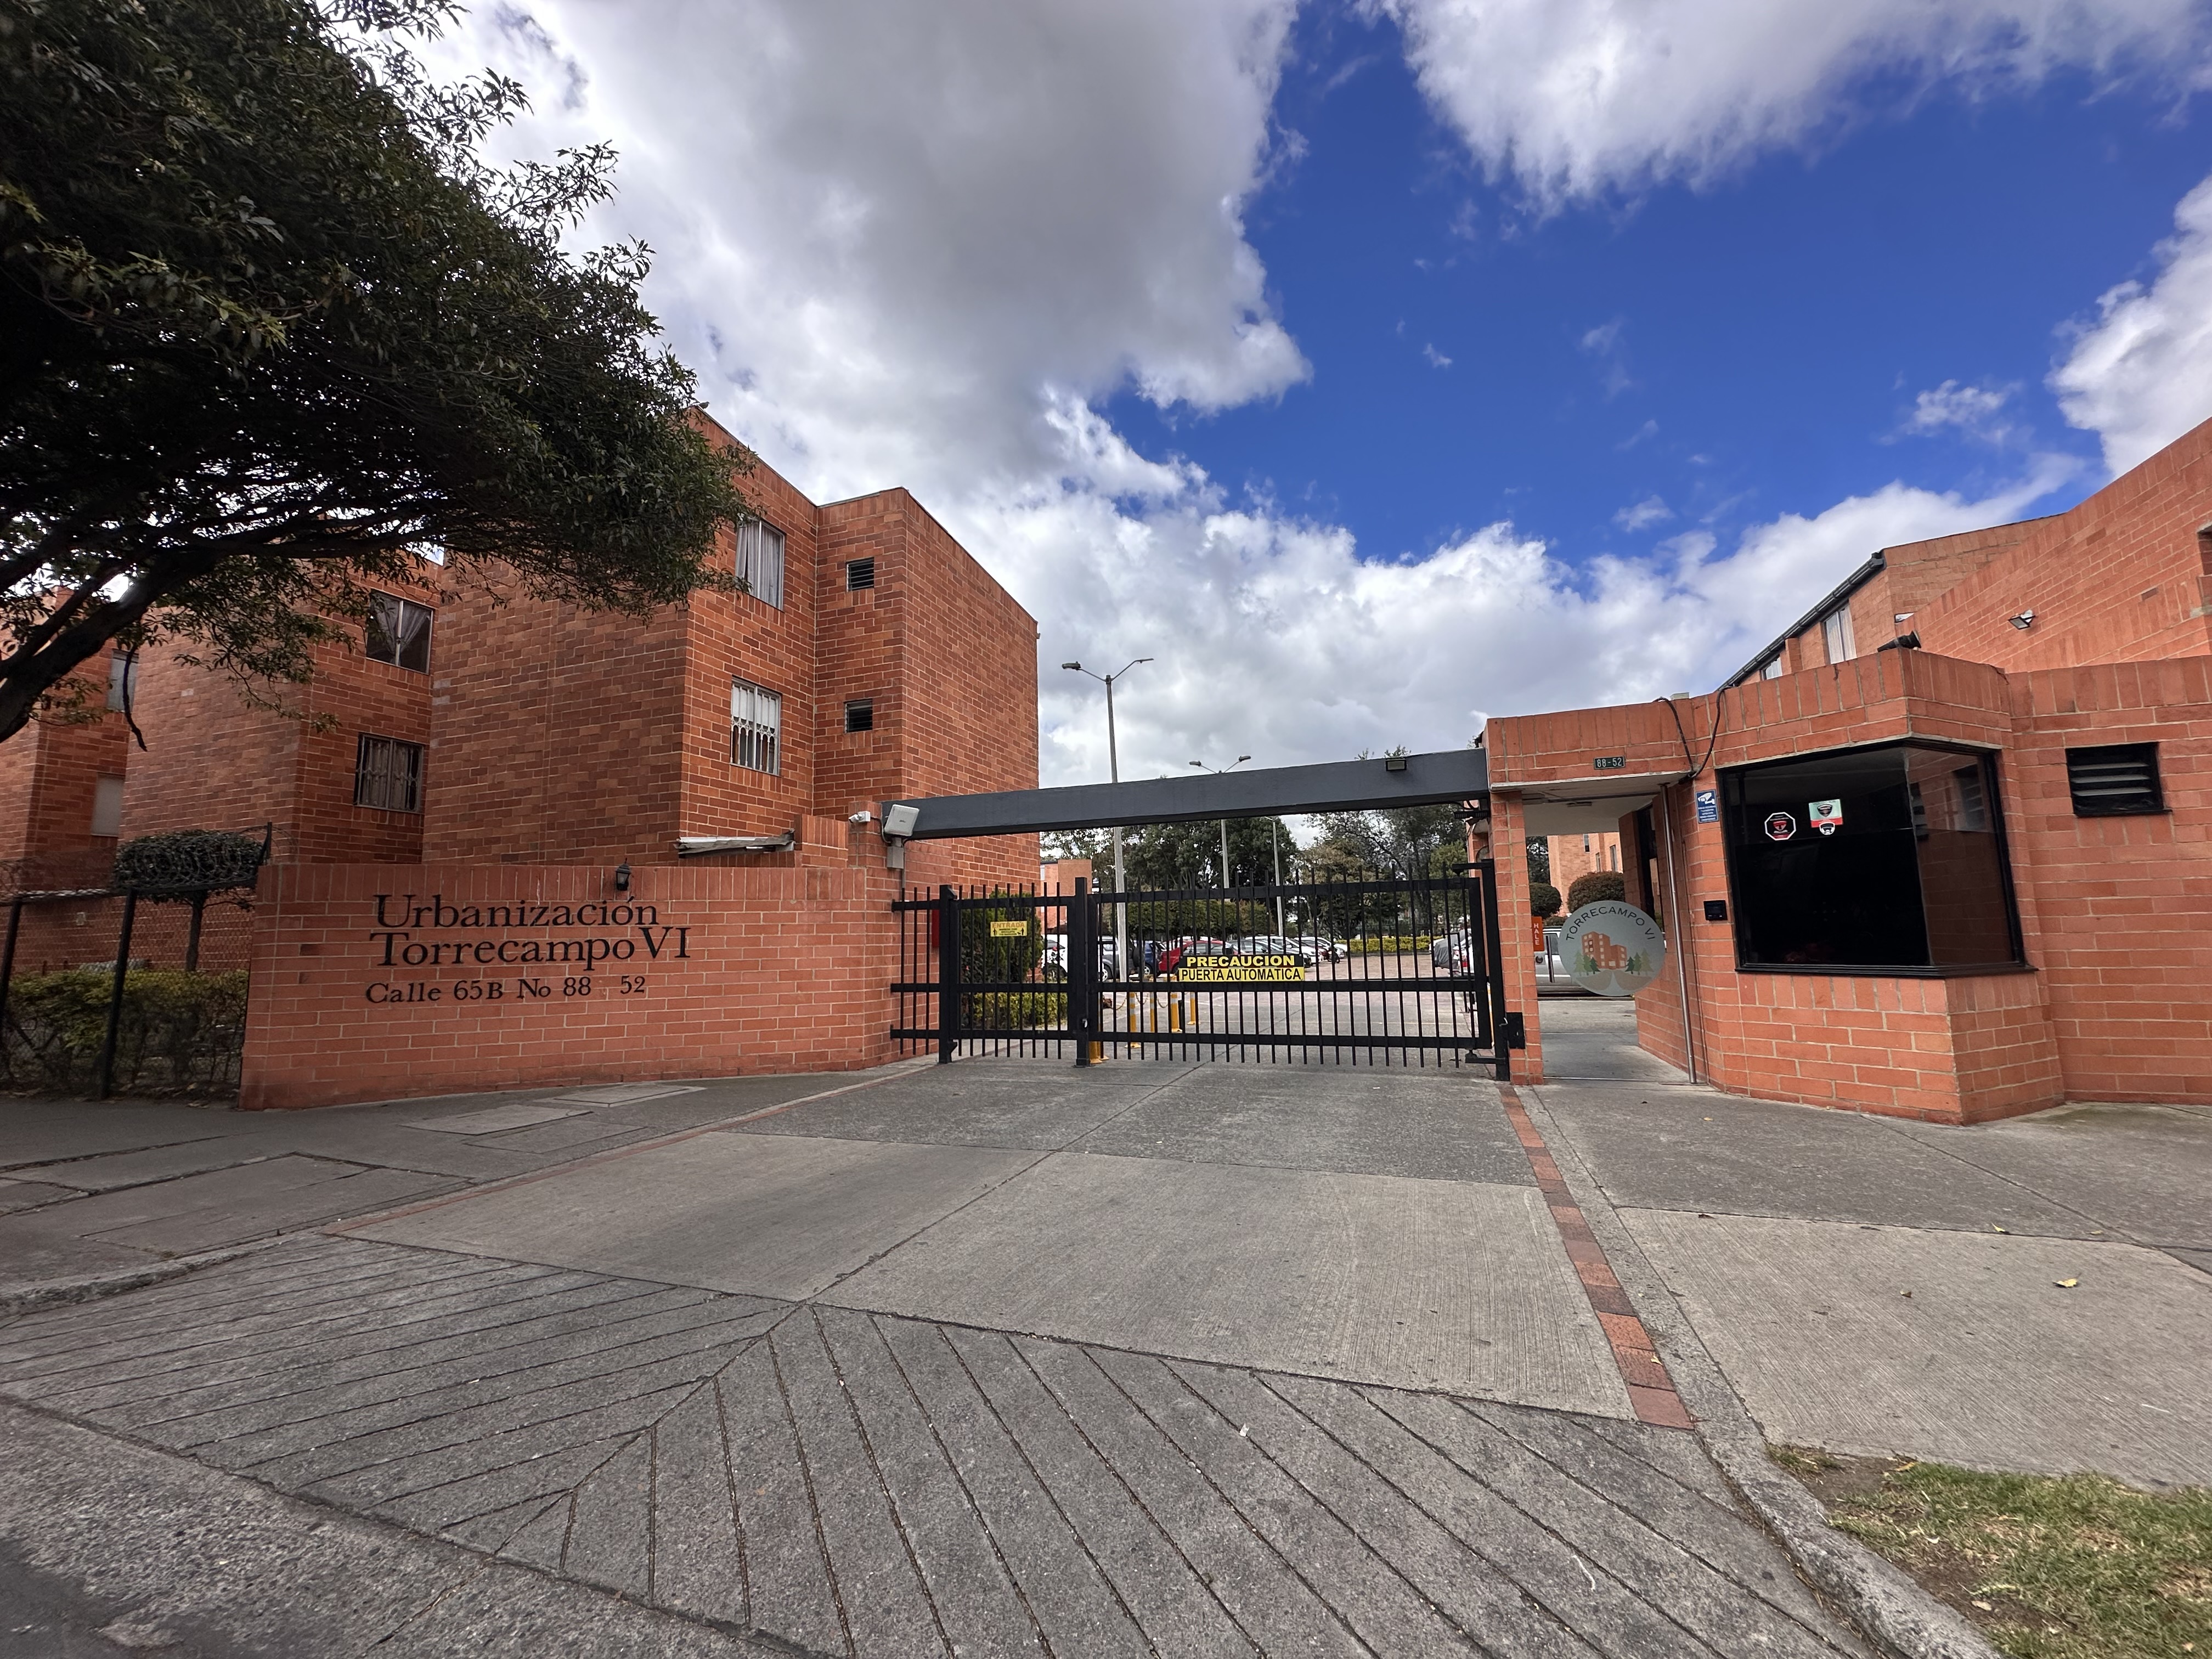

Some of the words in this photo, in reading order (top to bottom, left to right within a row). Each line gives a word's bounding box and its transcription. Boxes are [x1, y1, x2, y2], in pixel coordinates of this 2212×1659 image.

[1597, 758, 1622, 768] 88-52
[373, 894, 659, 928] Urbanización
[1566, 906, 1645, 940] TORRECAMPO
[1645, 928, 1655, 940] VI
[369, 932, 635, 971] Torrecampo
[638, 926, 691, 959] VI
[1187, 955, 1295, 967] PRECAUCION
[1181, 969, 1224, 980] PUERTA
[1226, 968, 1301, 980] AUTOMATICA
[365, 983, 442, 1003] Calle
[453, 980, 504, 1000] 65B
[516, 978, 551, 998] No
[563, 977, 591, 996] 88
[620, 975, 646, 994] 52
